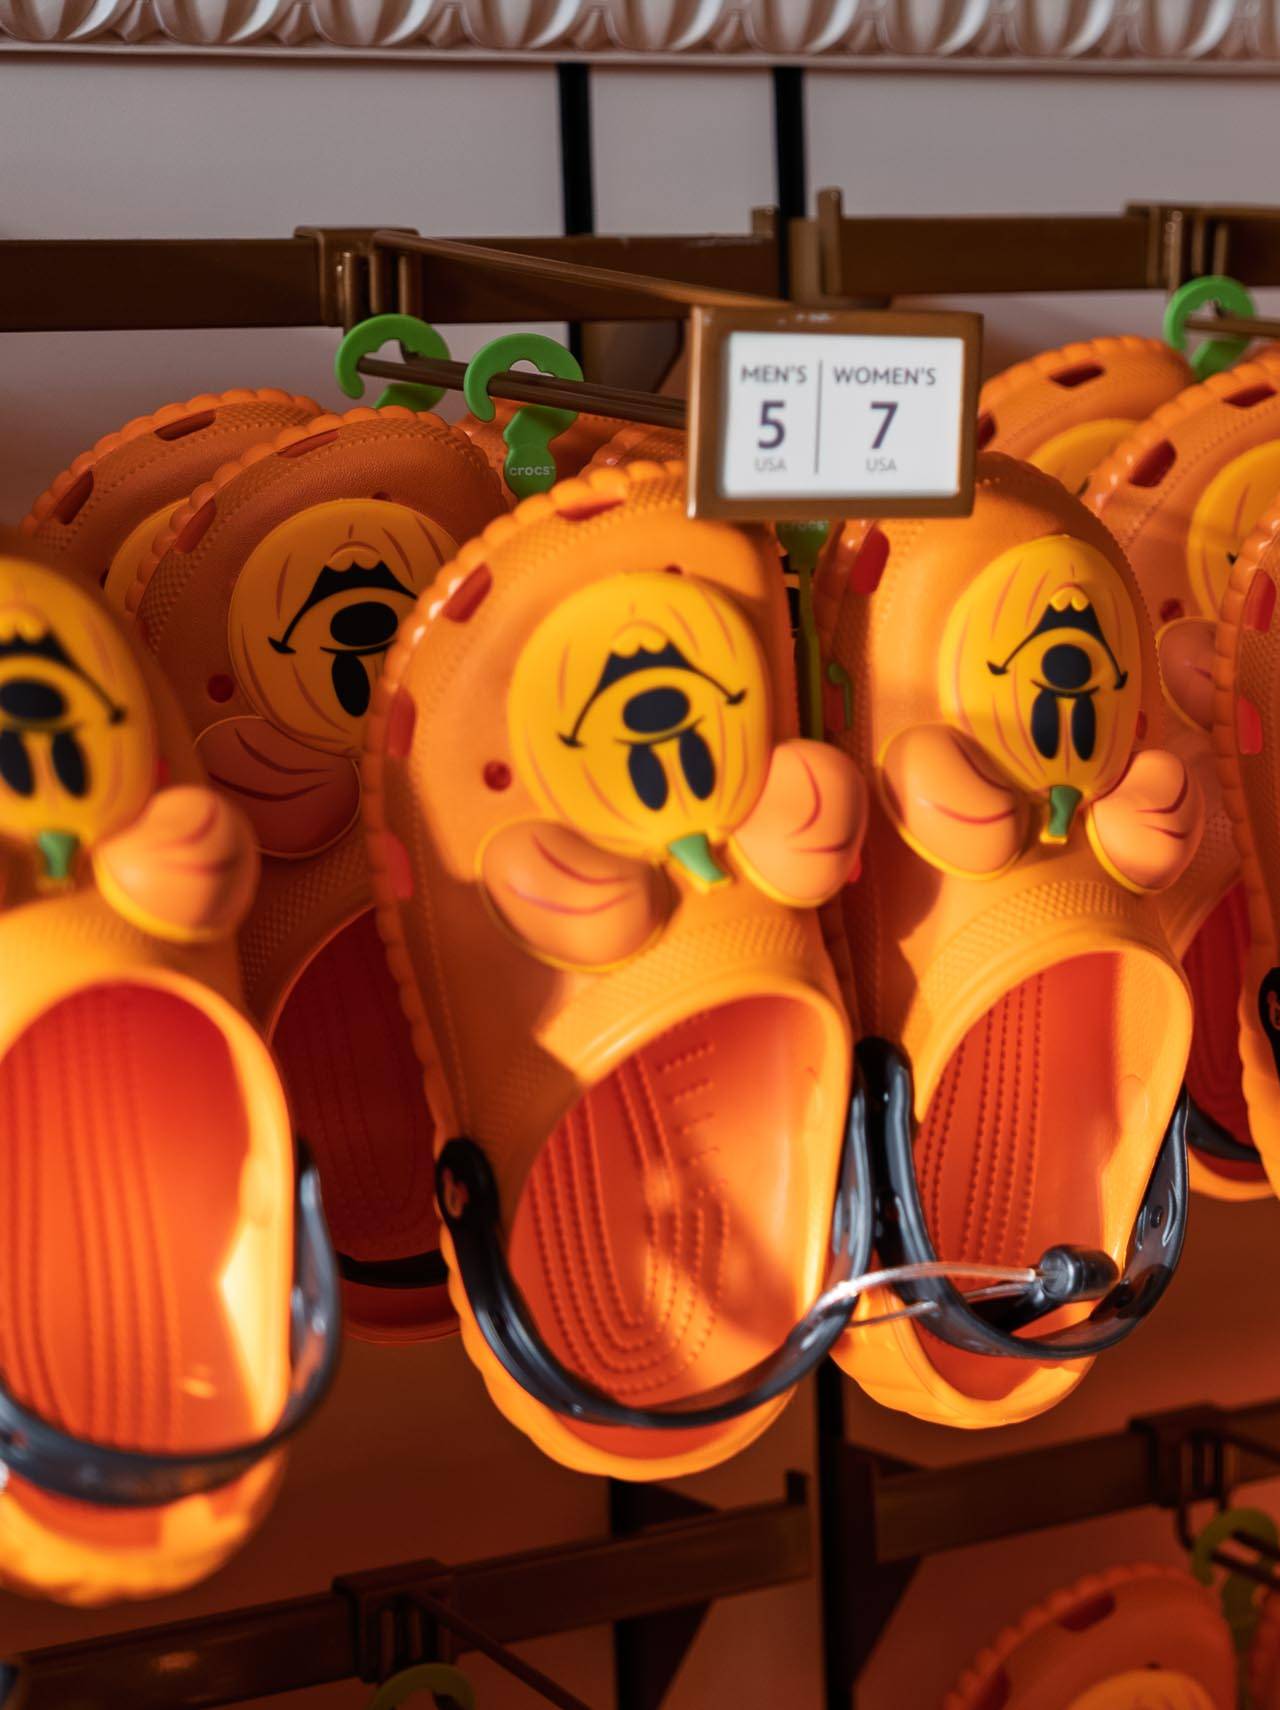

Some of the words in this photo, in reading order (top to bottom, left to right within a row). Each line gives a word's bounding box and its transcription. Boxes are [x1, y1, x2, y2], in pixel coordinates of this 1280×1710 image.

[740, 365, 807, 384] MEN'S
[833, 366, 937, 386] WOMEN'S
[757, 399, 786, 450] 5
[870, 401, 899, 450] 7
[754, 457, 787, 473] USA
[865, 457, 897, 473] USA
